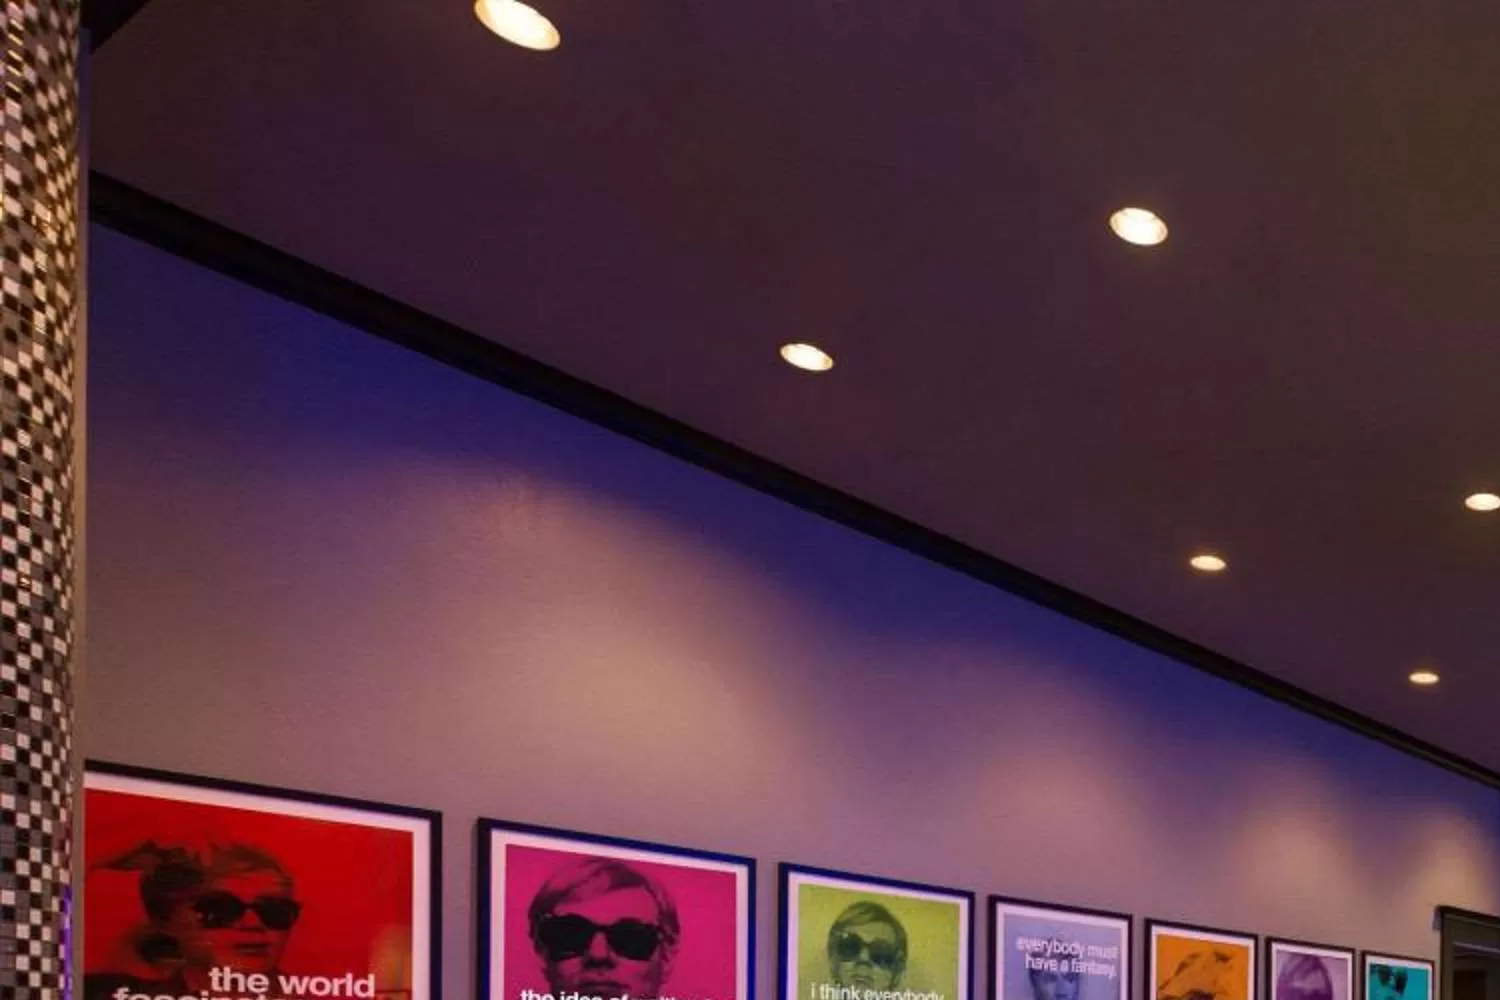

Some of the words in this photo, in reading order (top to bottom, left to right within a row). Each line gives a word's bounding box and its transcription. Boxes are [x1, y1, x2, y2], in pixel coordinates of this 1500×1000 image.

[1016, 937, 1084, 959] everybody
[1025, 953, 1058, 972] have
[209, 966, 269, 993] the
[278, 973, 375, 997] world
[811, 982, 816, 999] i
[820, 983, 860, 1000] think
